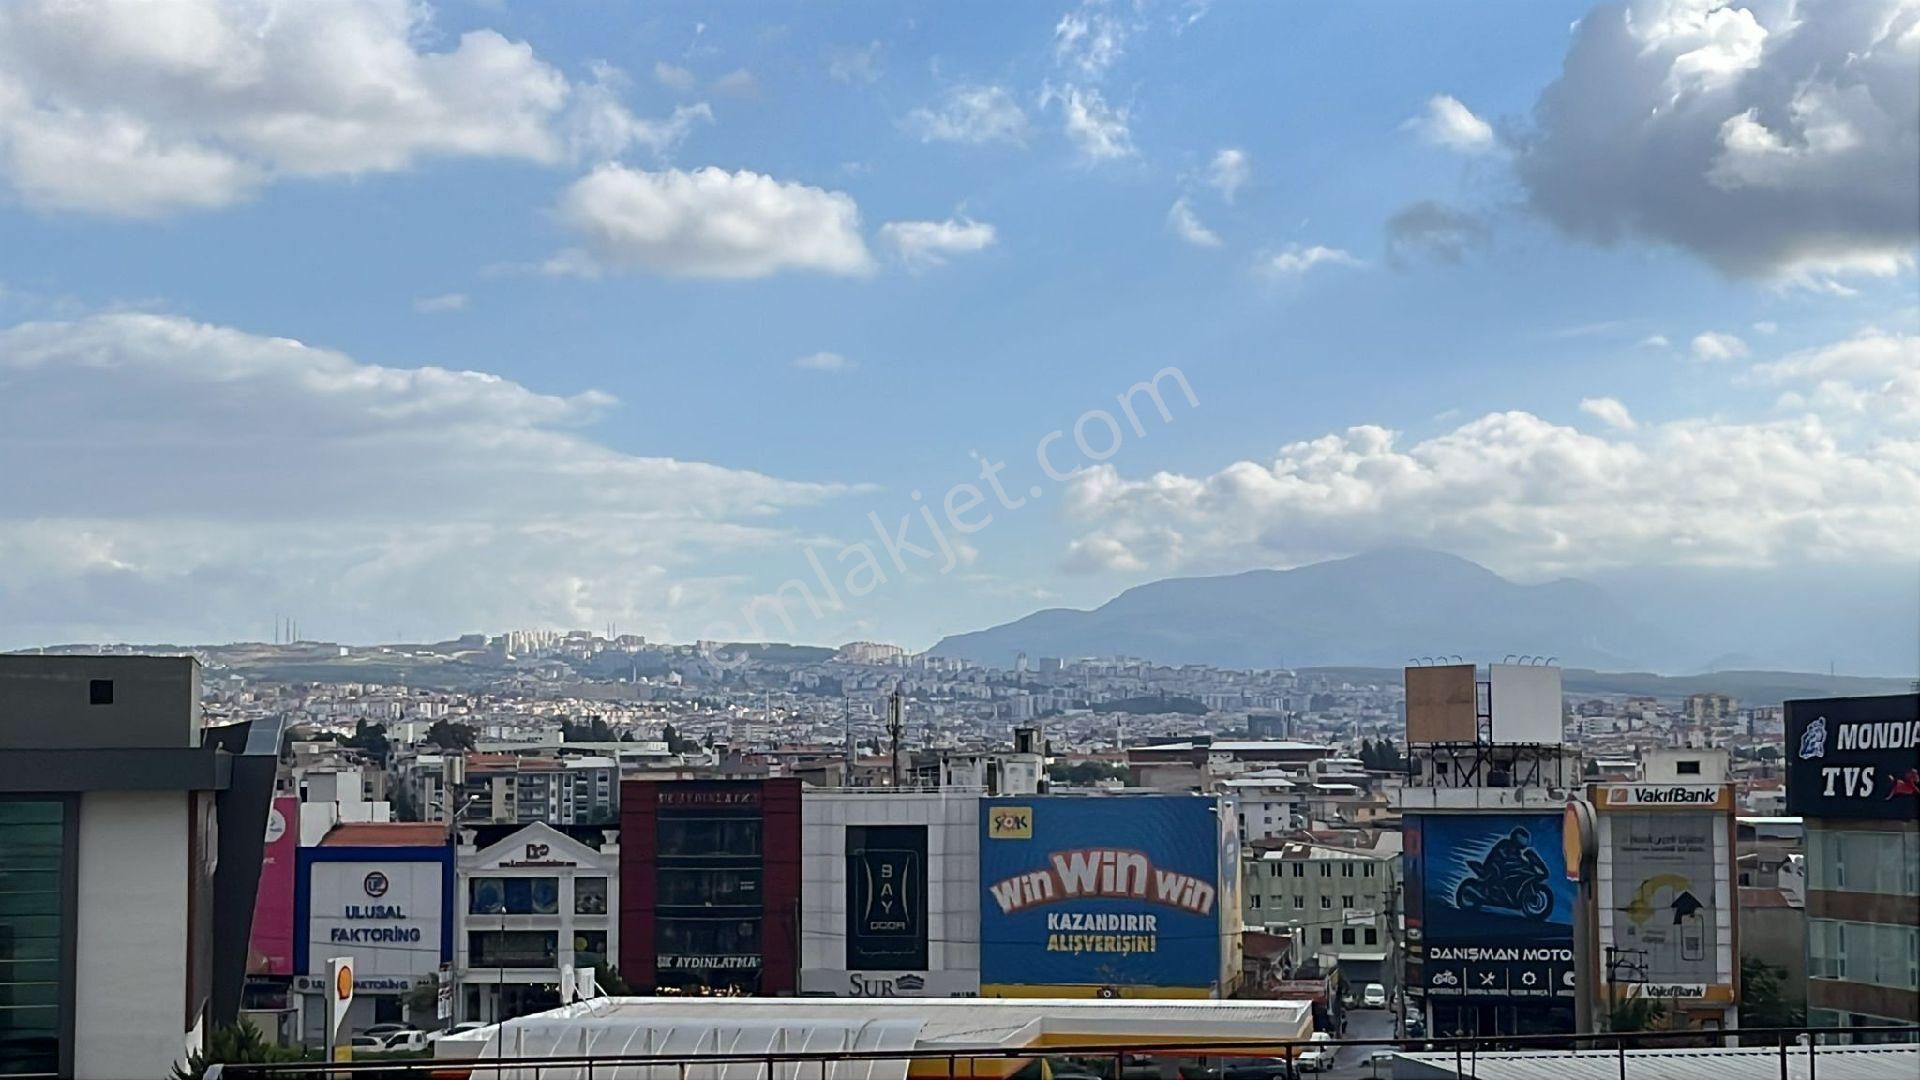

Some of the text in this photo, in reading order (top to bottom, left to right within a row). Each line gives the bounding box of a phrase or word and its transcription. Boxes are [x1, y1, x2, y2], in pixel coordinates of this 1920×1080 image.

[1822, 767, 1875, 797] TVS
[345, 905, 407, 919] ULUSAL
[1048, 912, 1157, 932] KAZANDIRIR
[330, 925, 421, 942] FAKTORİNG
[1430, 947, 1575, 962] DANIŞMAN MOTO
[675, 956, 757, 969] AYDINLATMA
[355, 979, 409, 990] AKTORİNG
